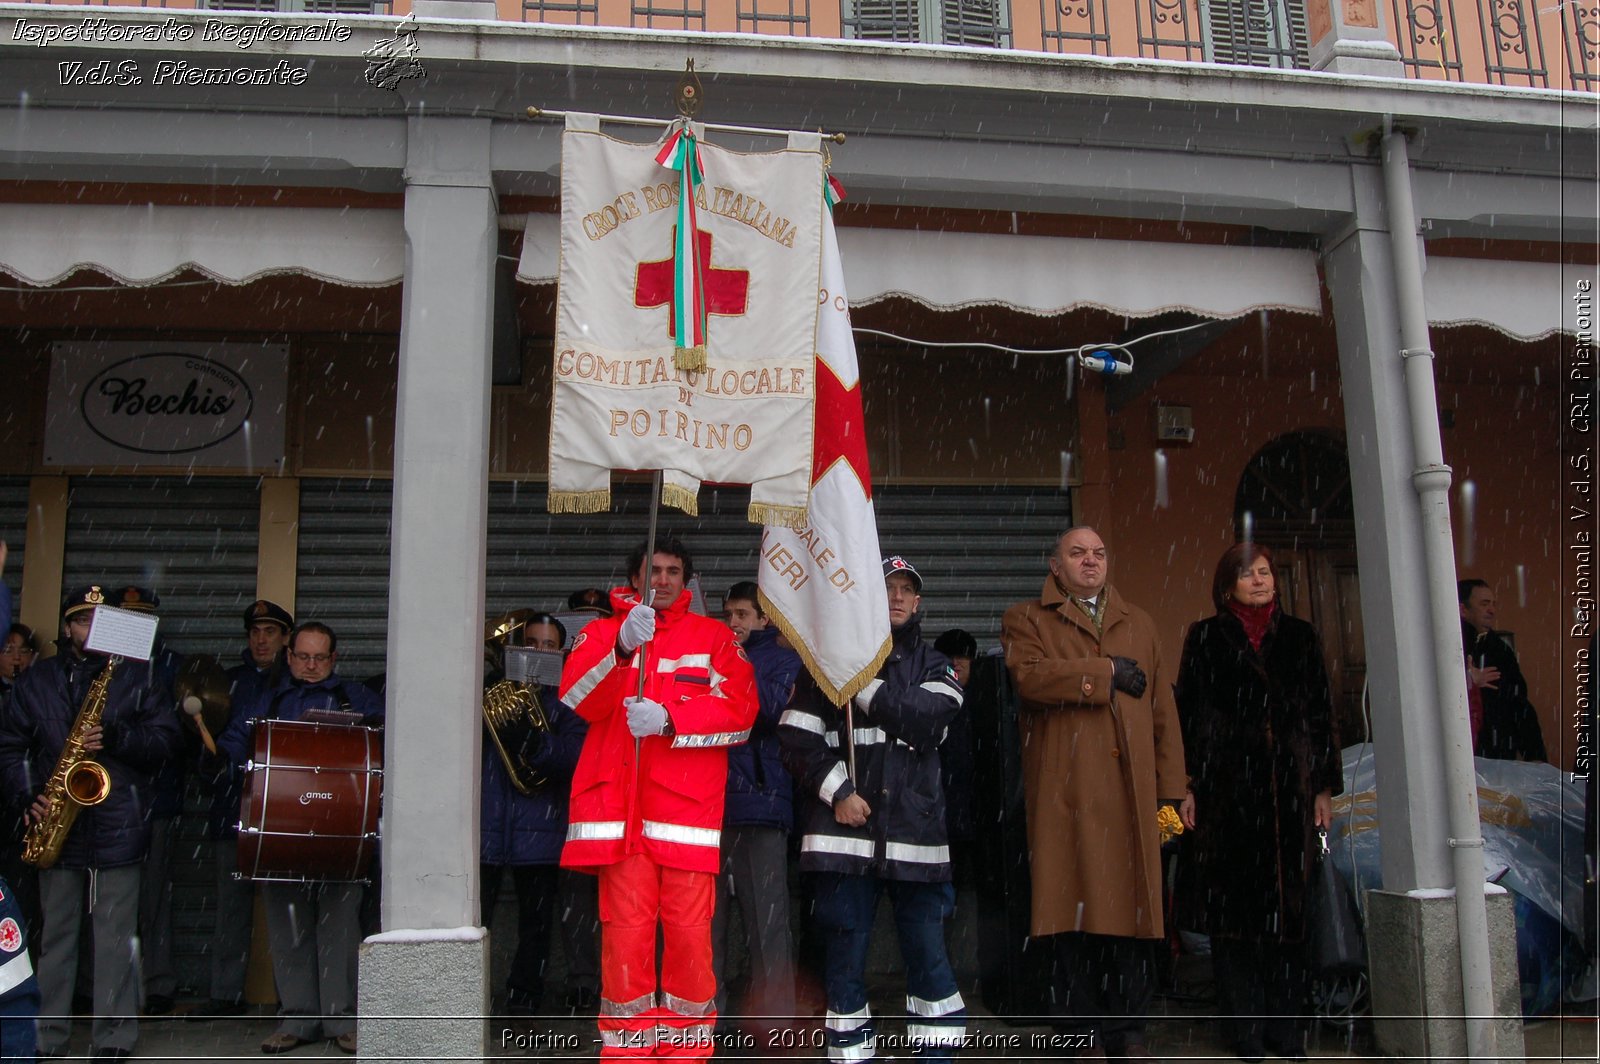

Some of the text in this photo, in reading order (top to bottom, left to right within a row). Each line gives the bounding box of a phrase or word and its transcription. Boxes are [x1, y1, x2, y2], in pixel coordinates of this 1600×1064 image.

[582, 181, 798, 249] CROCE ROSA ITALIANA
[184, 360, 238, 388] Confezioni
[705, 366, 805, 395] LOCALE
[100, 377, 235, 415] Bechis
[678, 386, 693, 407] DI
[609, 408, 753, 451] POIRINO
[828, 567, 855, 594] DI
